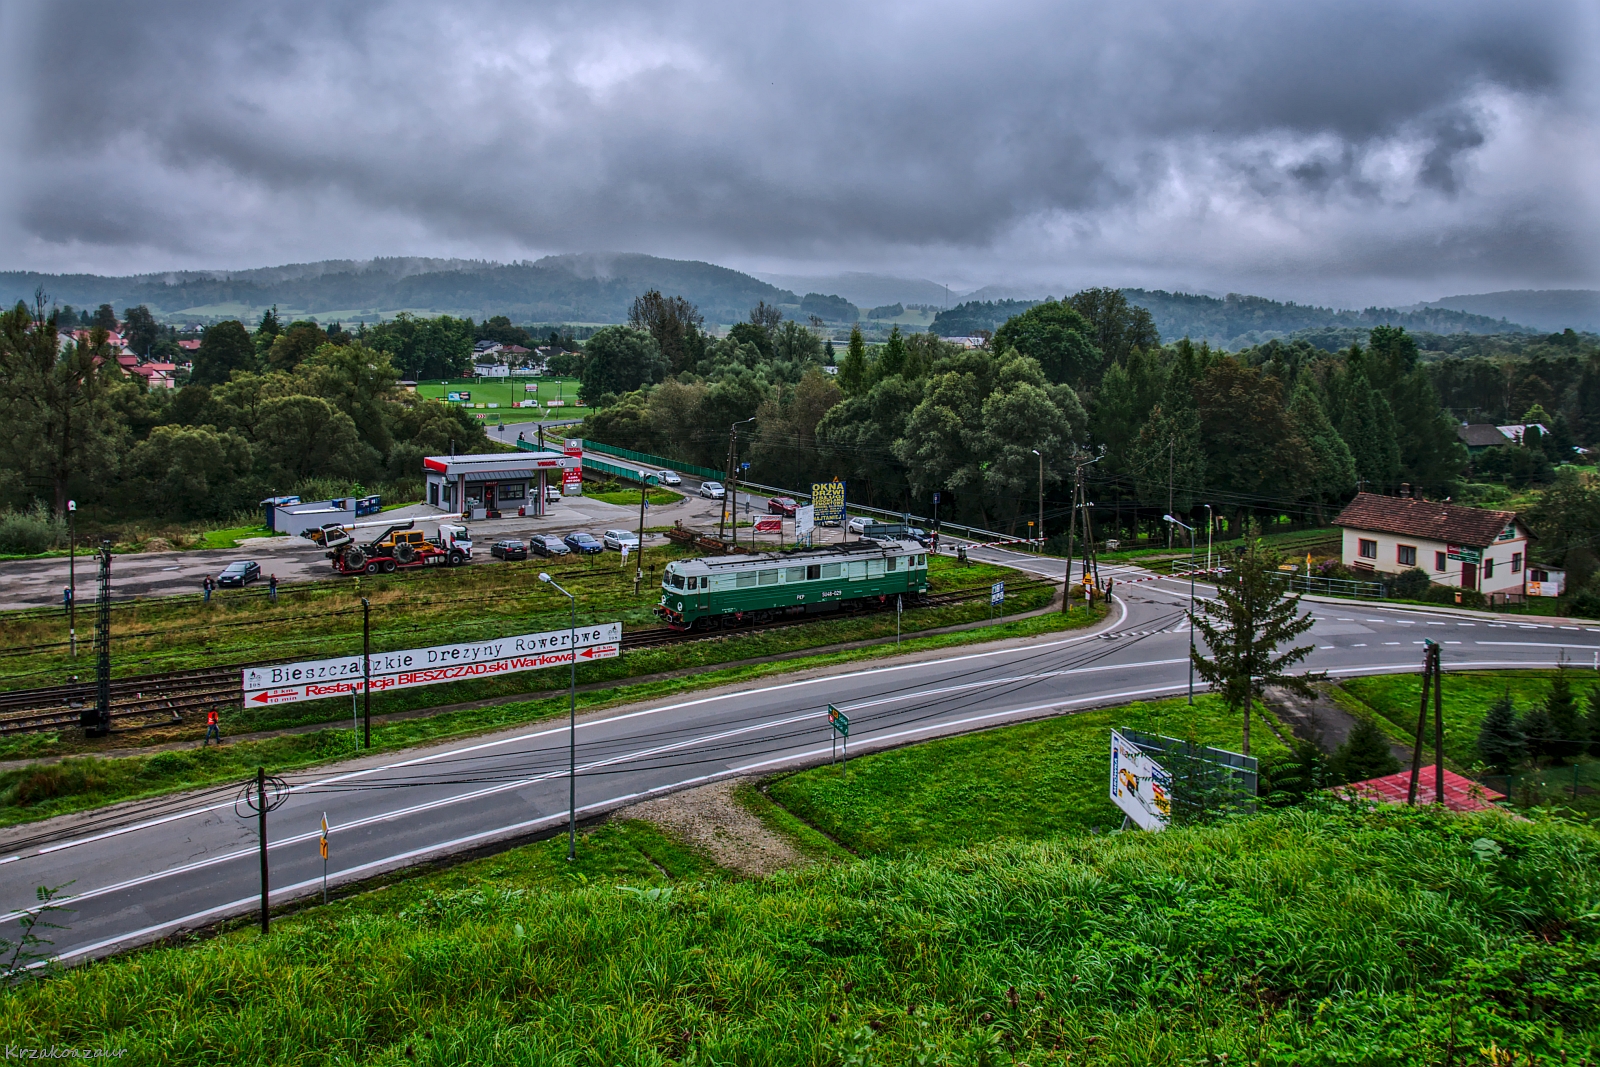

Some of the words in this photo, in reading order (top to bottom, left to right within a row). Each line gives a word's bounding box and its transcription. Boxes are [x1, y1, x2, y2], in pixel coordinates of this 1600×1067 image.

[812, 483, 844, 491] OKNA
[427, 644, 502, 663] Drezyny
[515, 630, 601, 651] Rowerowe
[398, 660, 508, 685] BIESZCZAD.ski
[510, 653, 576, 669] Wańkowa
